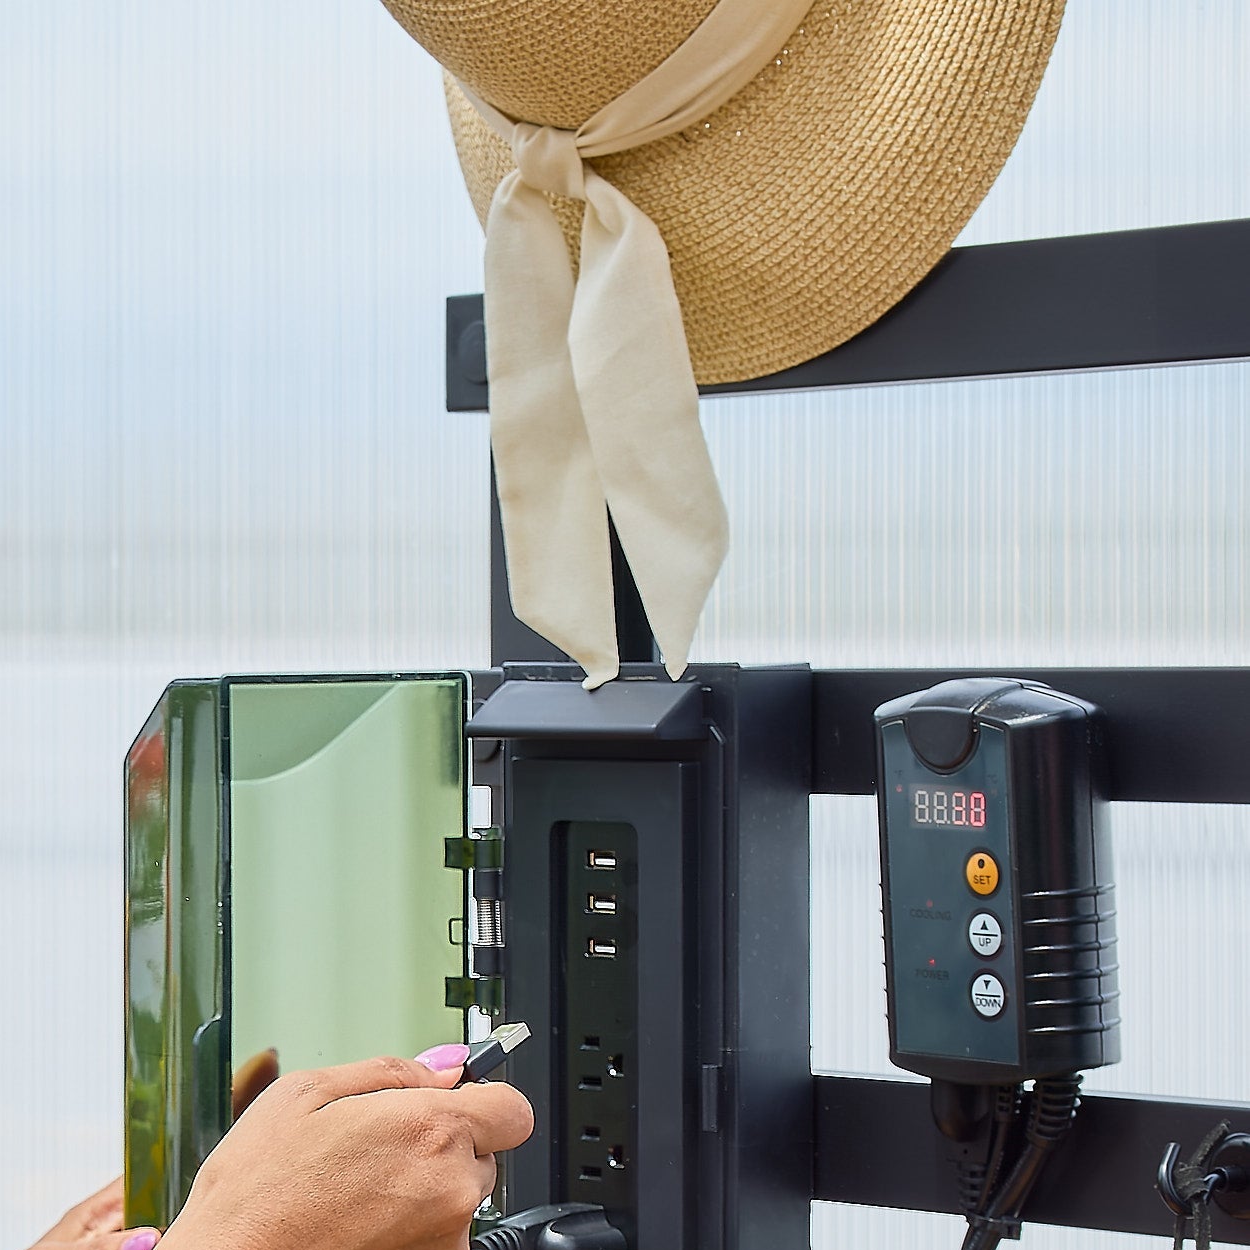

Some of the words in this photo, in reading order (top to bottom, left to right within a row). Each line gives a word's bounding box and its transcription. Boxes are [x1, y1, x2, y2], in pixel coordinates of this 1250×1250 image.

[973, 874, 992, 885] SET
[978, 937, 992, 947] UP
[974, 997, 1001, 1009] DOWN
